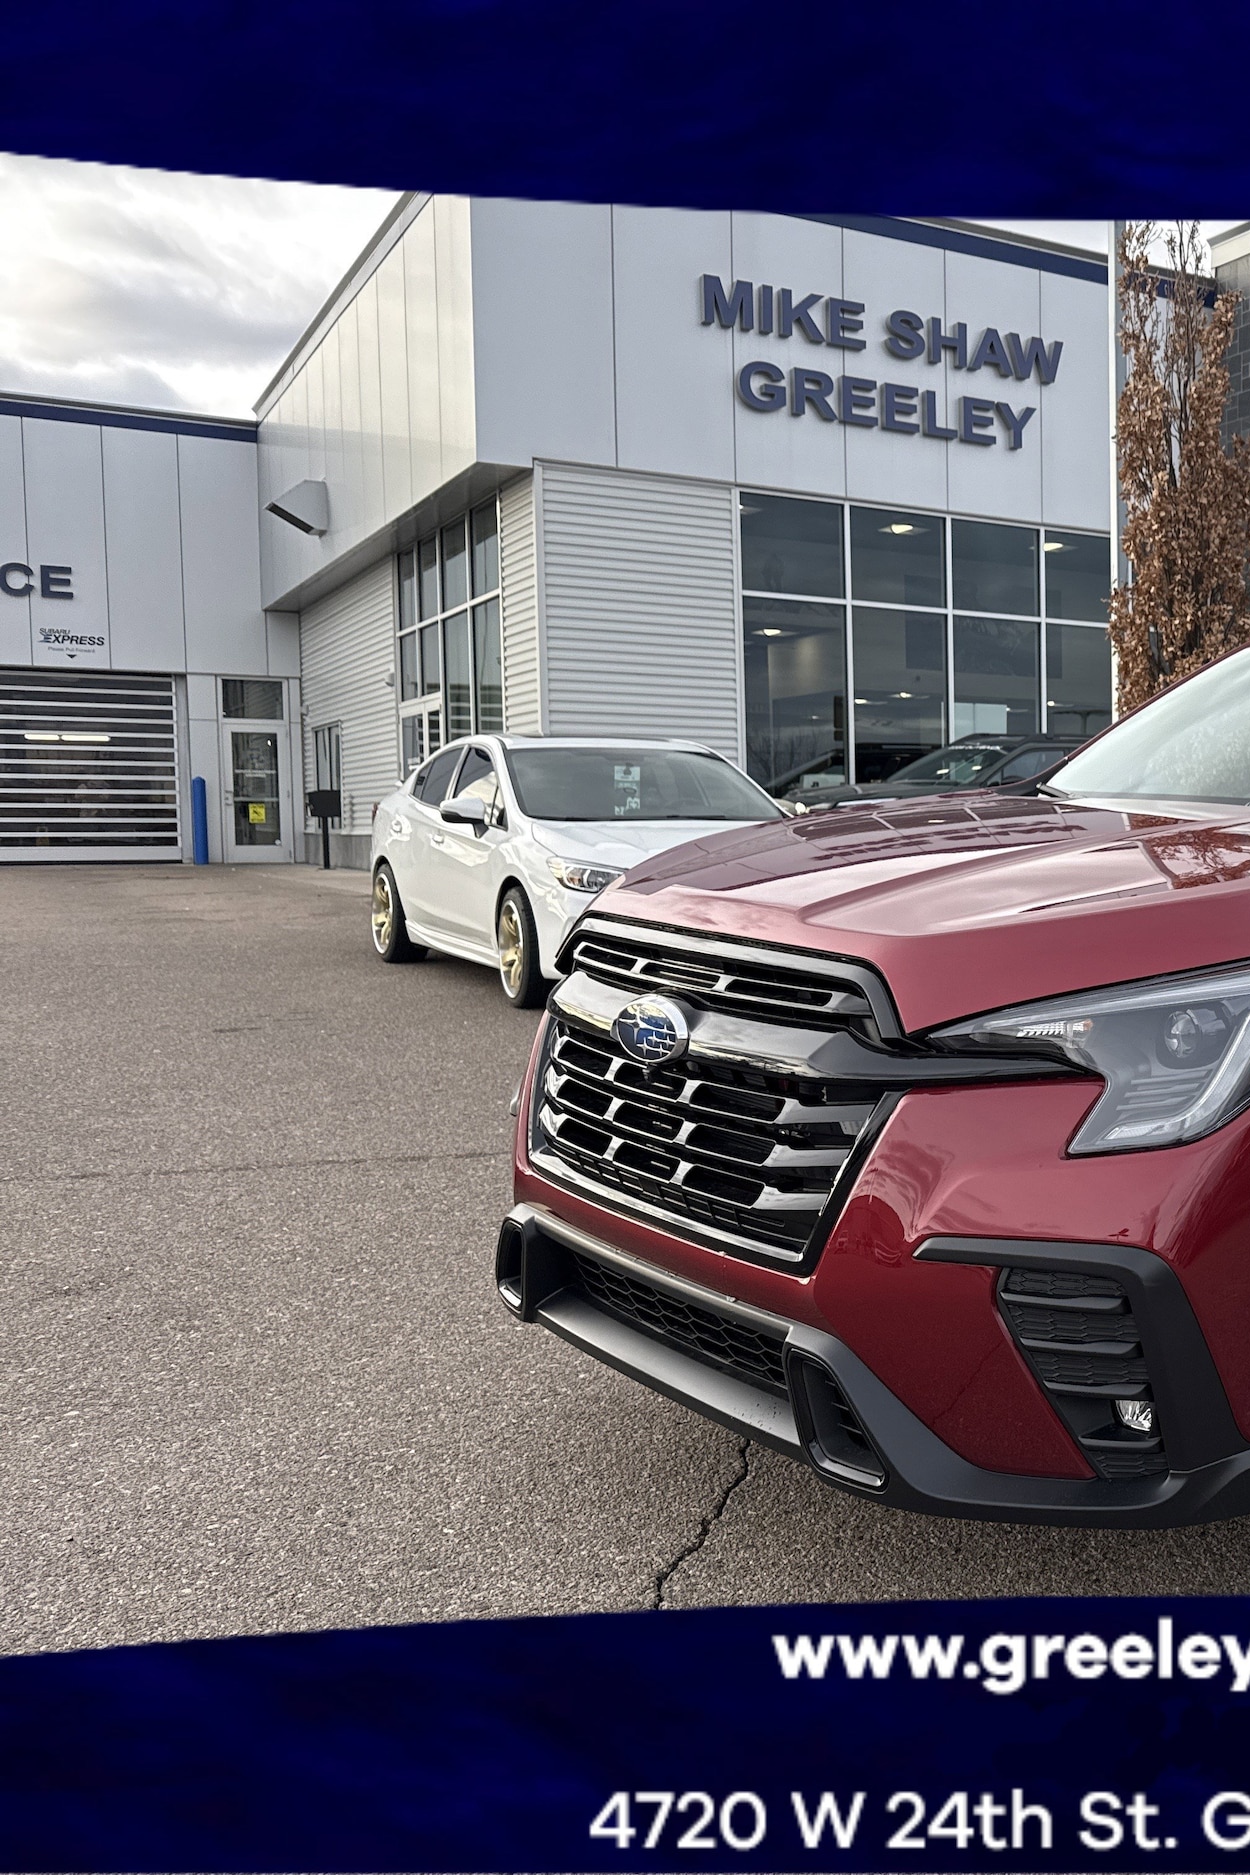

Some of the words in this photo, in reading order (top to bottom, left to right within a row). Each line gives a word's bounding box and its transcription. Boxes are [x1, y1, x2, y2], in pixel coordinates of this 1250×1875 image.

[701, 274, 867, 351] MIKE
[884, 309, 1064, 385] SHAW
[737, 360, 1037, 450] GREELEY
[39, 627, 71, 635] SUBARU
[40, 634, 105, 646] EXPRESS
